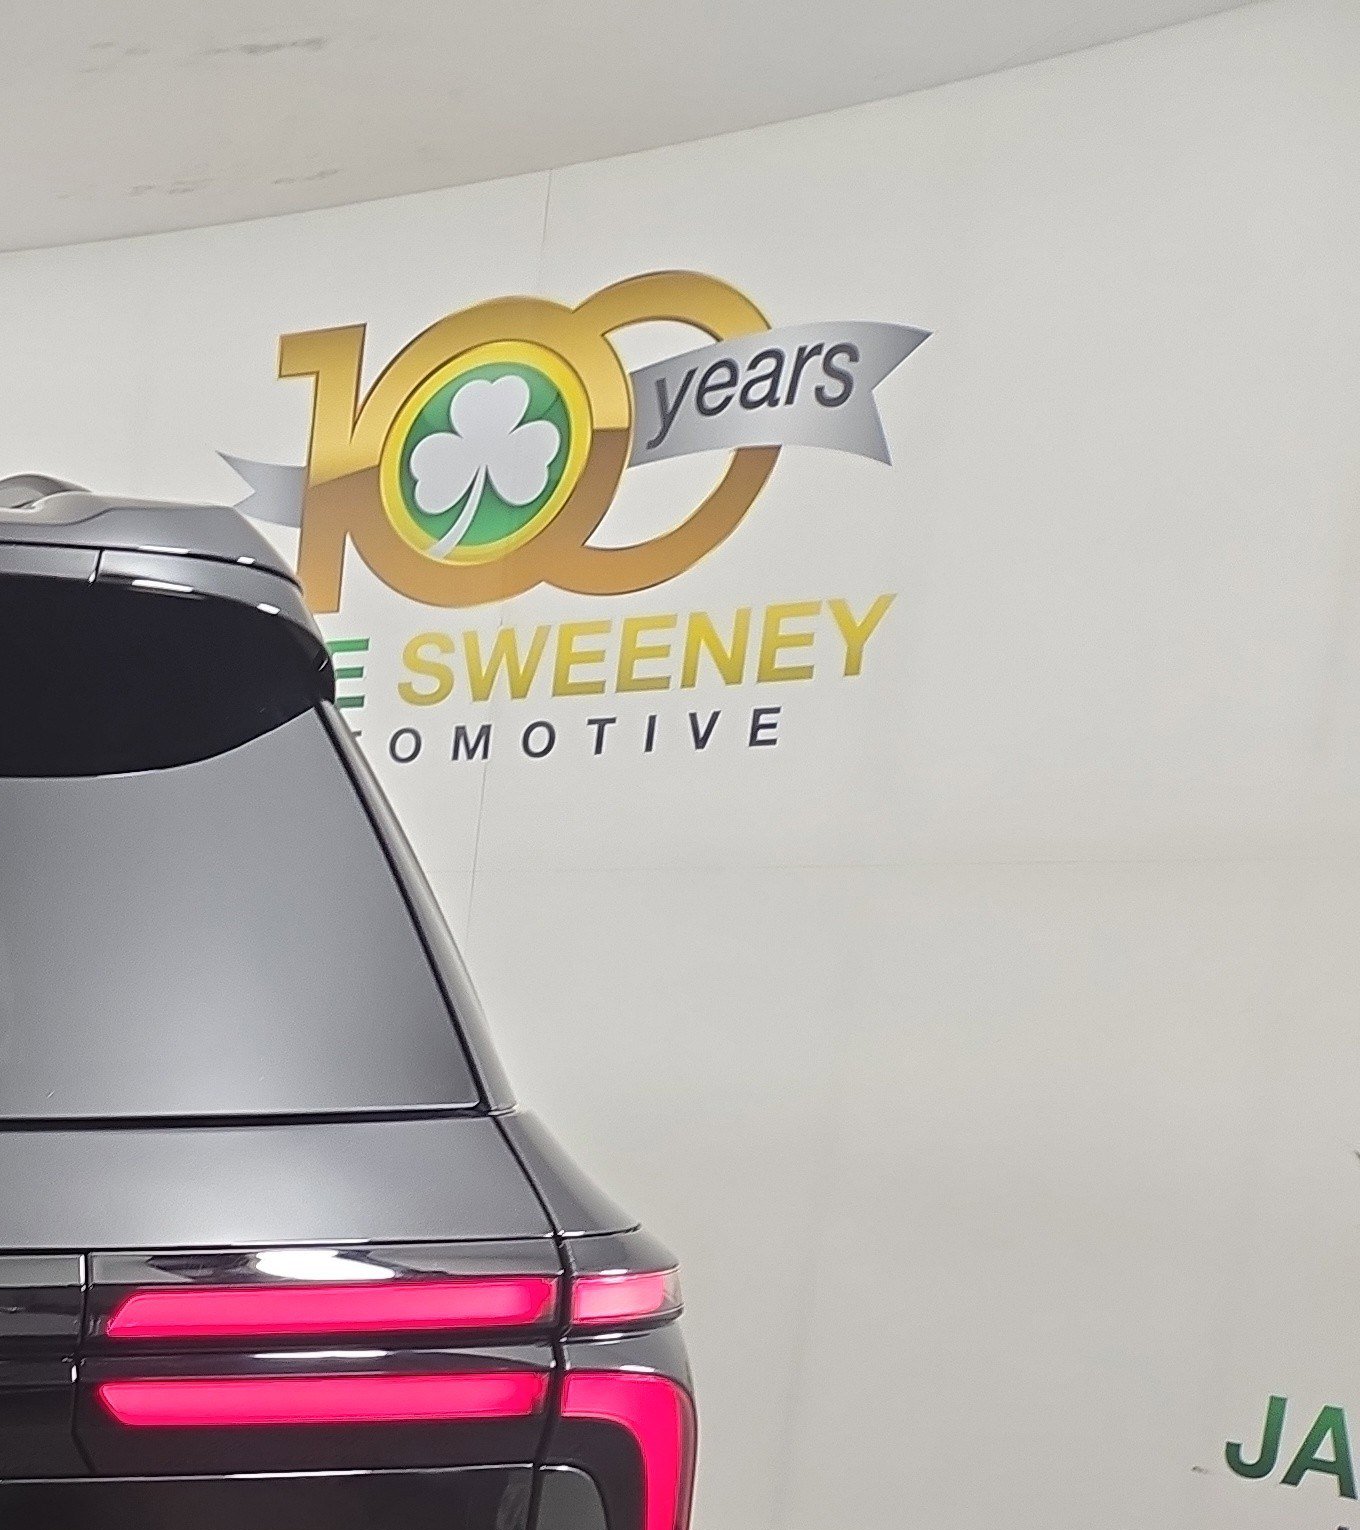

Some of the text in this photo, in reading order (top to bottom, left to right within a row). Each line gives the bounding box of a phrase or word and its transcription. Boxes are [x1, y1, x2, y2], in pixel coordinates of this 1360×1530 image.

[277, 270, 781, 615] 100
[646, 341, 860, 450] years
[397, 594, 897, 706] SWEENEY
[352, 706, 782, 764] OMOTIVE
[1224, 1394, 1359, 1500] JA
